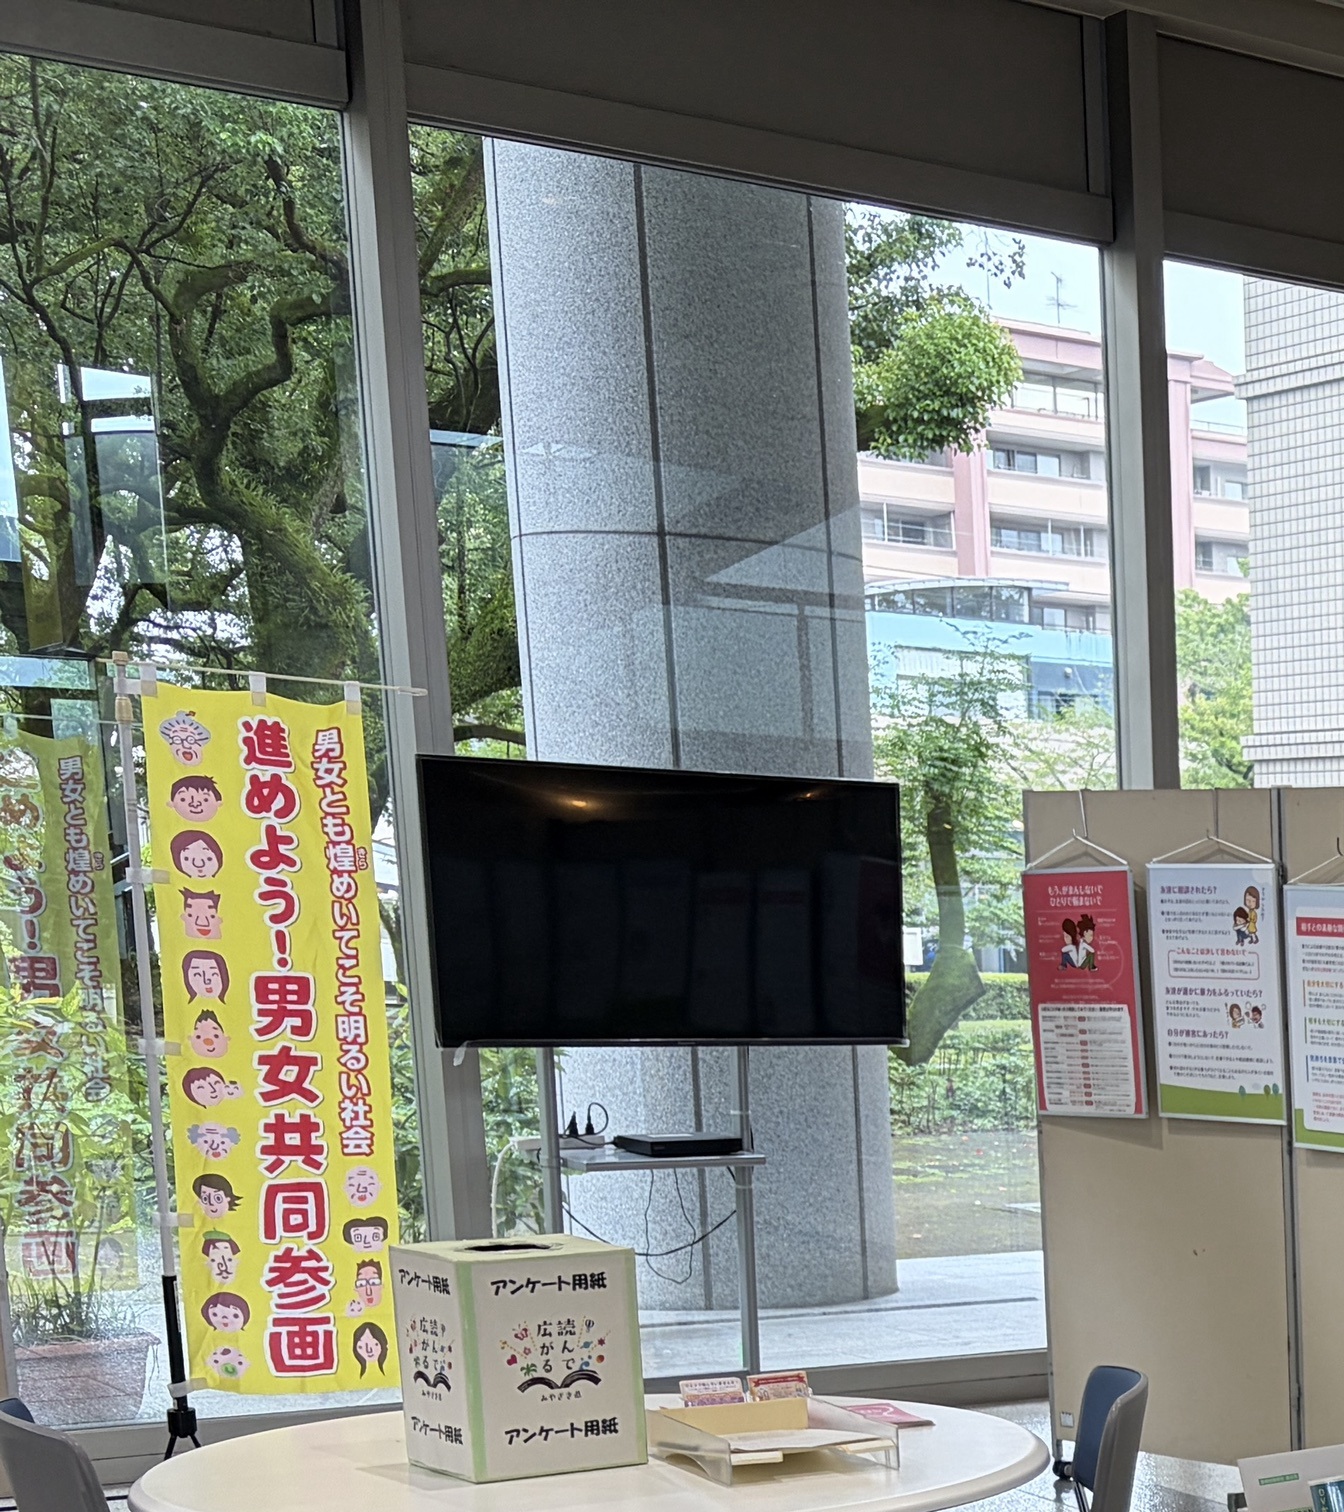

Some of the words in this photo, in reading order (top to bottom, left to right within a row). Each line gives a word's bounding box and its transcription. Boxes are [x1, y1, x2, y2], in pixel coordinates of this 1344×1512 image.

[312, 727, 373, 1157] 男女とも煌めいてこそ明るい社会
[238, 713, 337, 1378] 進めよう！男女共同参画
[398, 1268, 451, 1296] アンケート用紙
[490, 1271, 607, 1296] アンケート用紙
[536, 1320, 553, 1373] 広がる
[556, 1318, 576, 1370] 読んで
[411, 1415, 464, 1448] アンケート用紙
[505, 1417, 619, 1445] アンケート用紙
